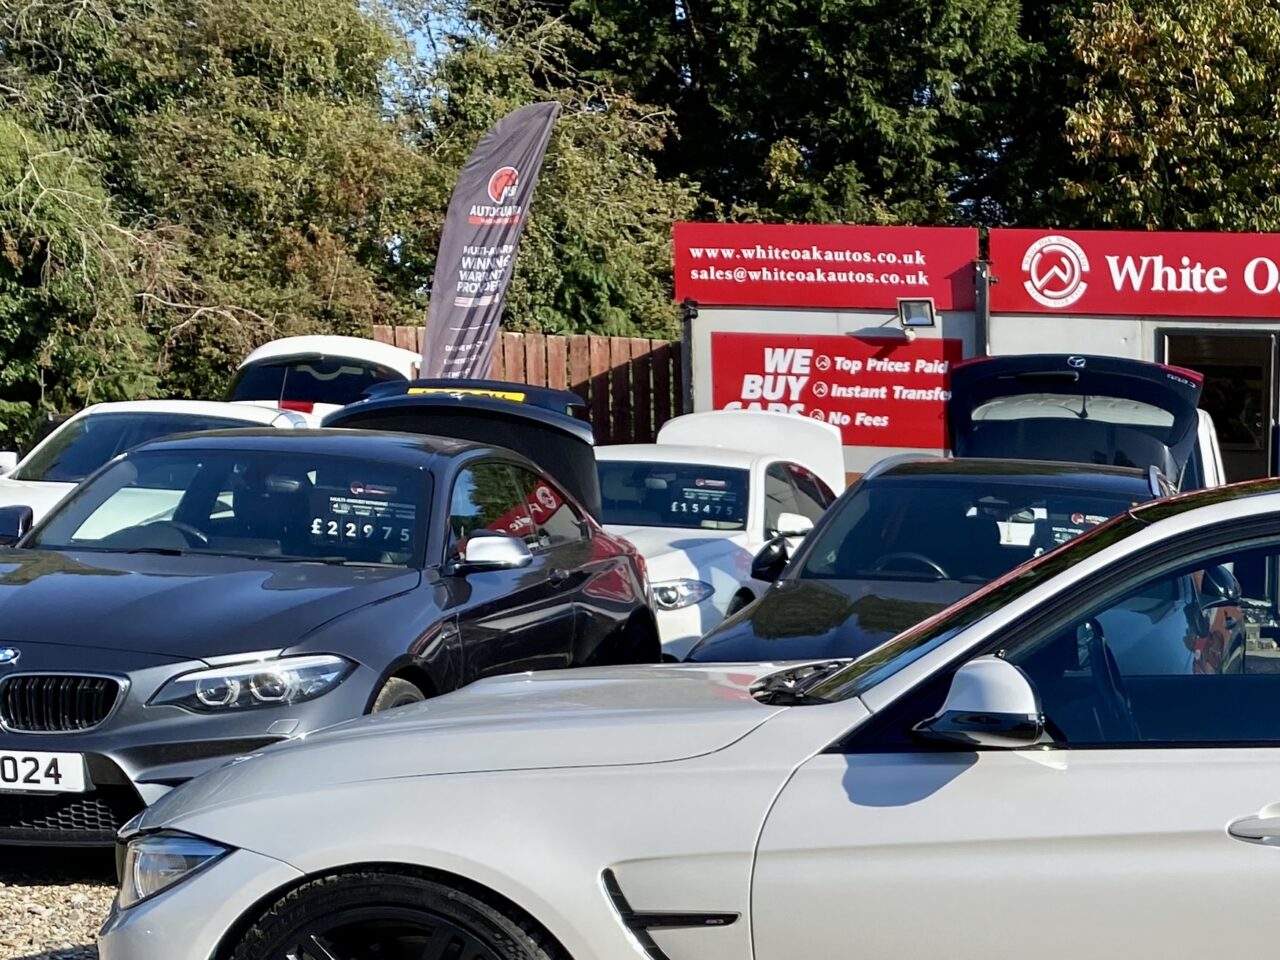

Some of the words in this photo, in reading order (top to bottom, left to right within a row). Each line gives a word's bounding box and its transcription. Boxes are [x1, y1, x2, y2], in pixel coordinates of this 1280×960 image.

[689, 245, 926, 266] www.whiteoakautos.co.uk
[690, 266, 929, 286] sales@whiteoakautos.co.uk
[1106, 255, 1227, 294] White
[763, 347, 814, 374] WE
[834, 356, 862, 374] Top
[866, 357, 910, 374] Prices
[915, 359, 949, 374] Paid
[741, 374, 810, 401] BUY
[830, 384, 887, 399] Instant
[893, 386, 952, 401] Transfe
[828, 412, 850, 426] No
[854, 412, 889, 427] Fees
[0, 755, 63, 785] 024
